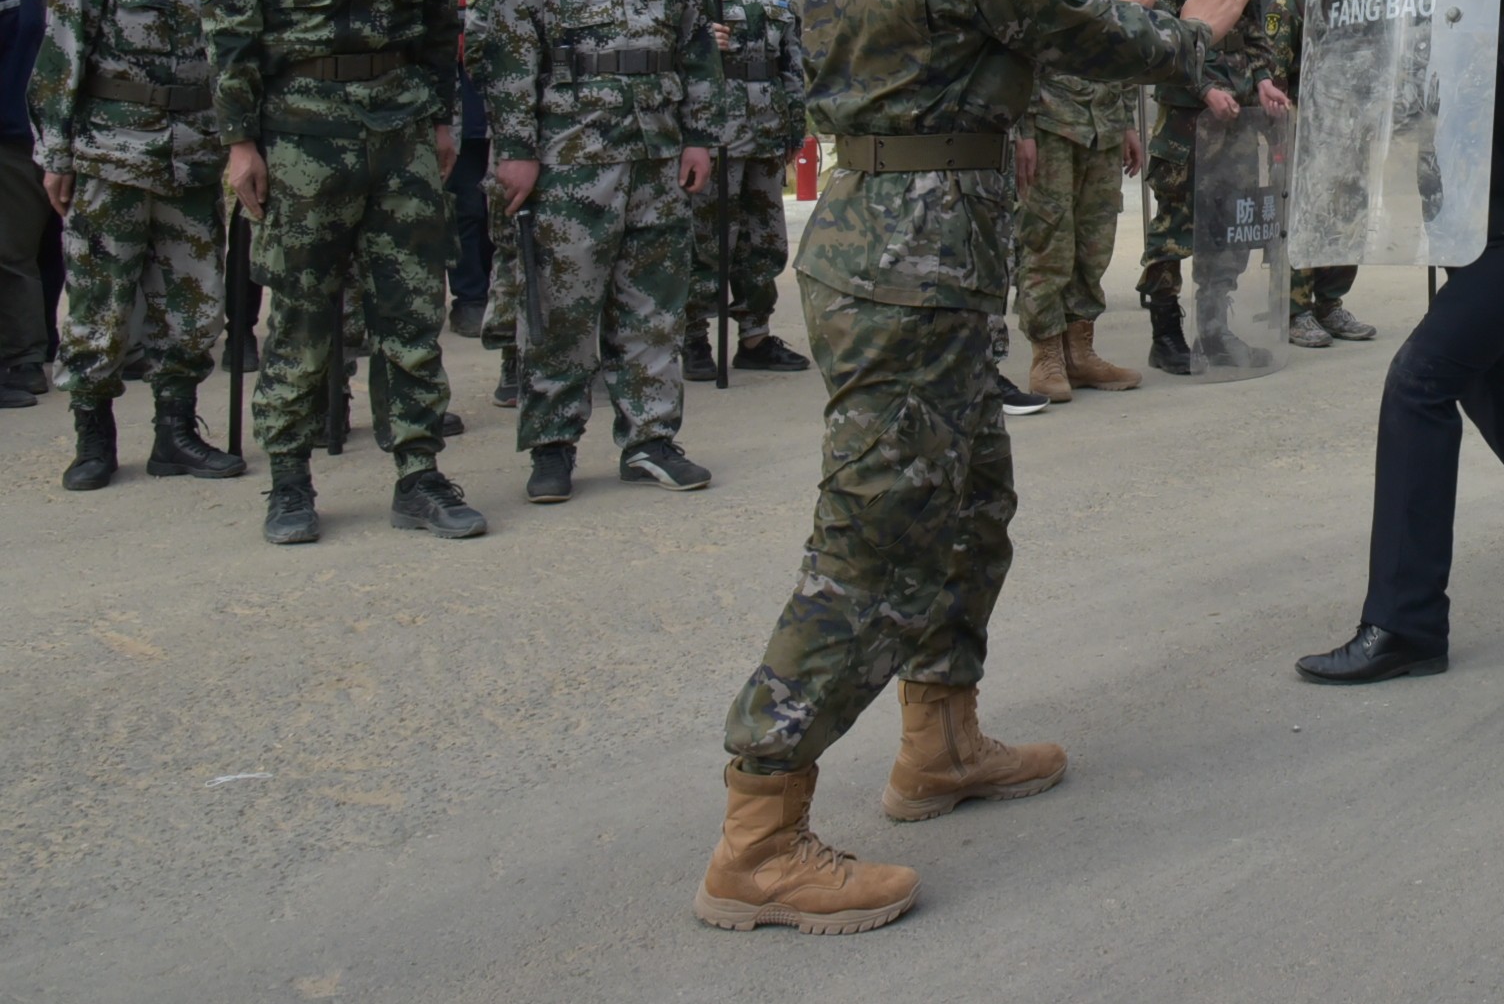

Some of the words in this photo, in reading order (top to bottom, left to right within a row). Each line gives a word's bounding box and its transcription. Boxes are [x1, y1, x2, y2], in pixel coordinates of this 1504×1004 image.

[1236, 196, 1275, 224] 防暴
[1227, 224, 1260, 243] FANG
[1263, 222, 1280, 239] BAO
